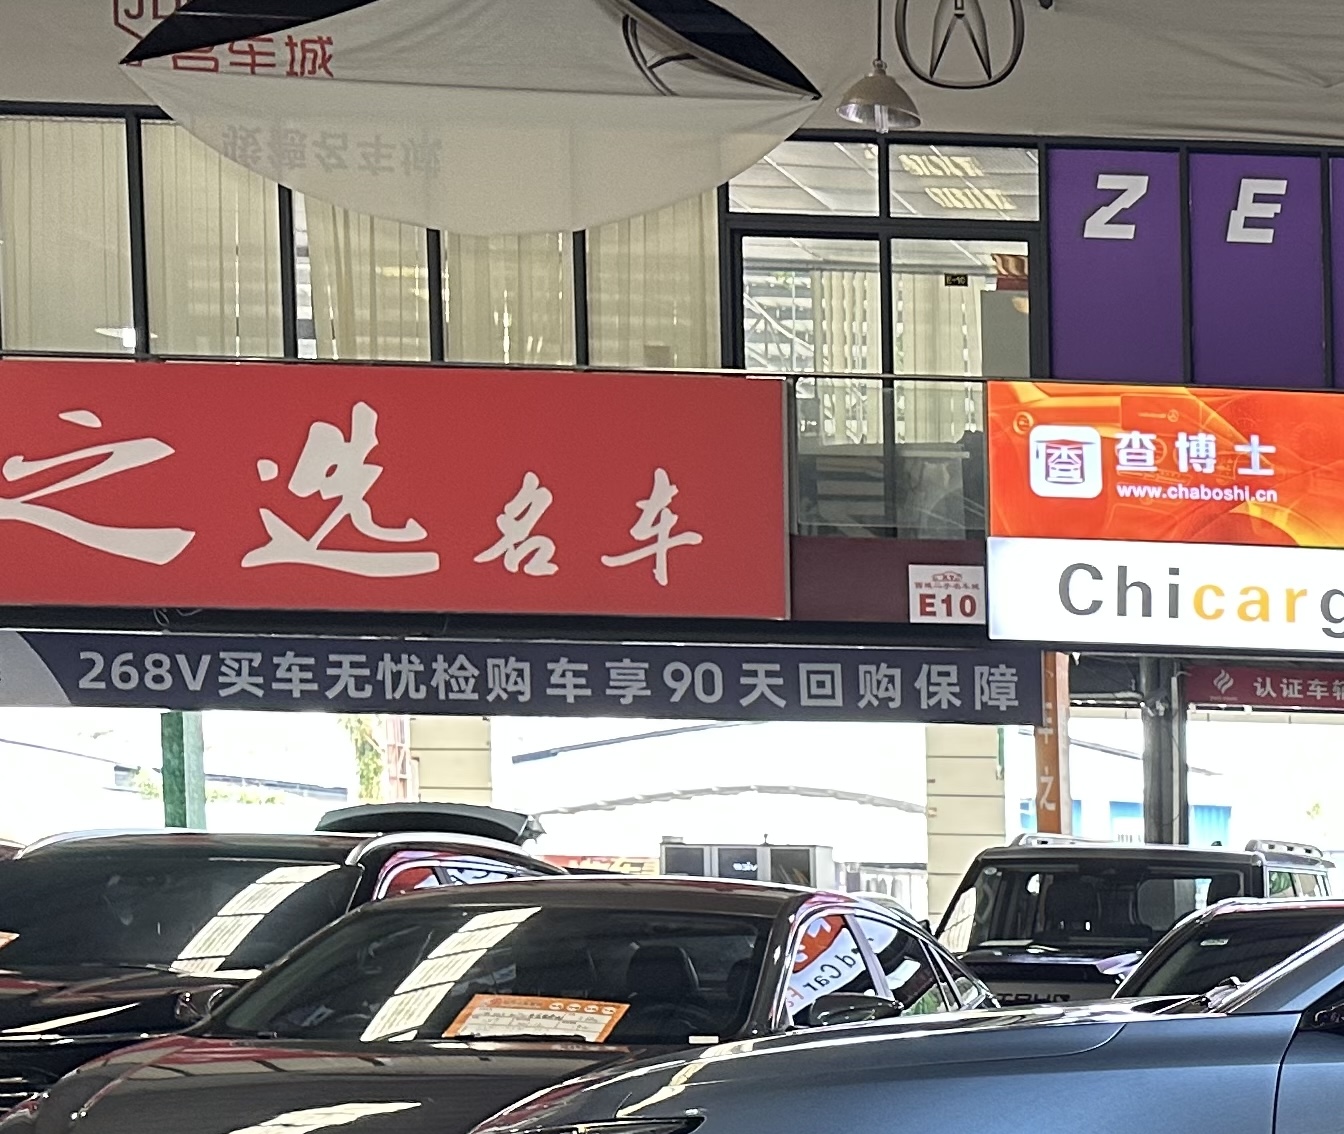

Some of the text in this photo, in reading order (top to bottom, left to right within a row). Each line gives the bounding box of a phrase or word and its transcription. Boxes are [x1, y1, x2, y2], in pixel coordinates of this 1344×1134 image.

[1115, 430, 1277, 476] 查博士
[1116, 483, 1277, 502] www.chaboshi.cn
[919, 593, 977, 618] E10
